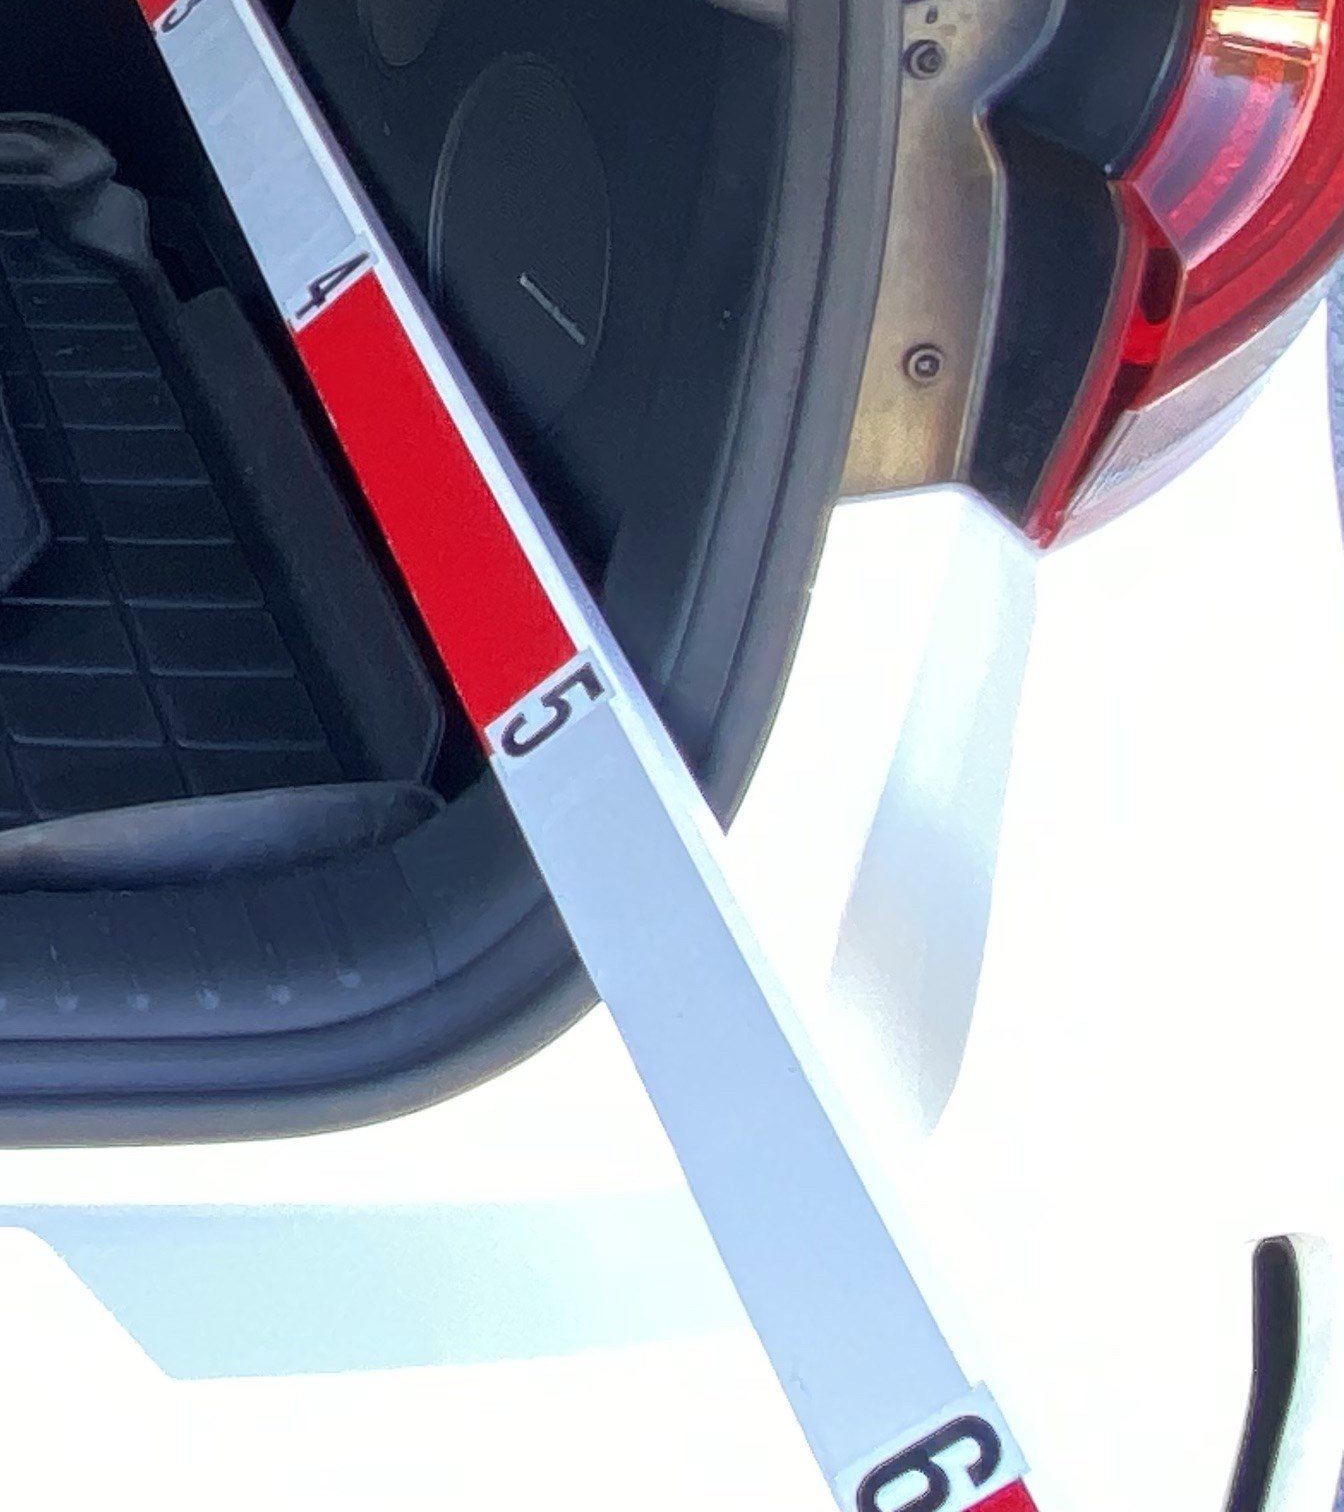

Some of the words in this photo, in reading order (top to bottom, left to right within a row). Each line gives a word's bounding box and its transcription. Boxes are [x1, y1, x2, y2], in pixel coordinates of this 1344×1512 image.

[295, 249, 370, 320] 4
[501, 661, 605, 758] 5
[856, 1414, 1003, 1512] 6
